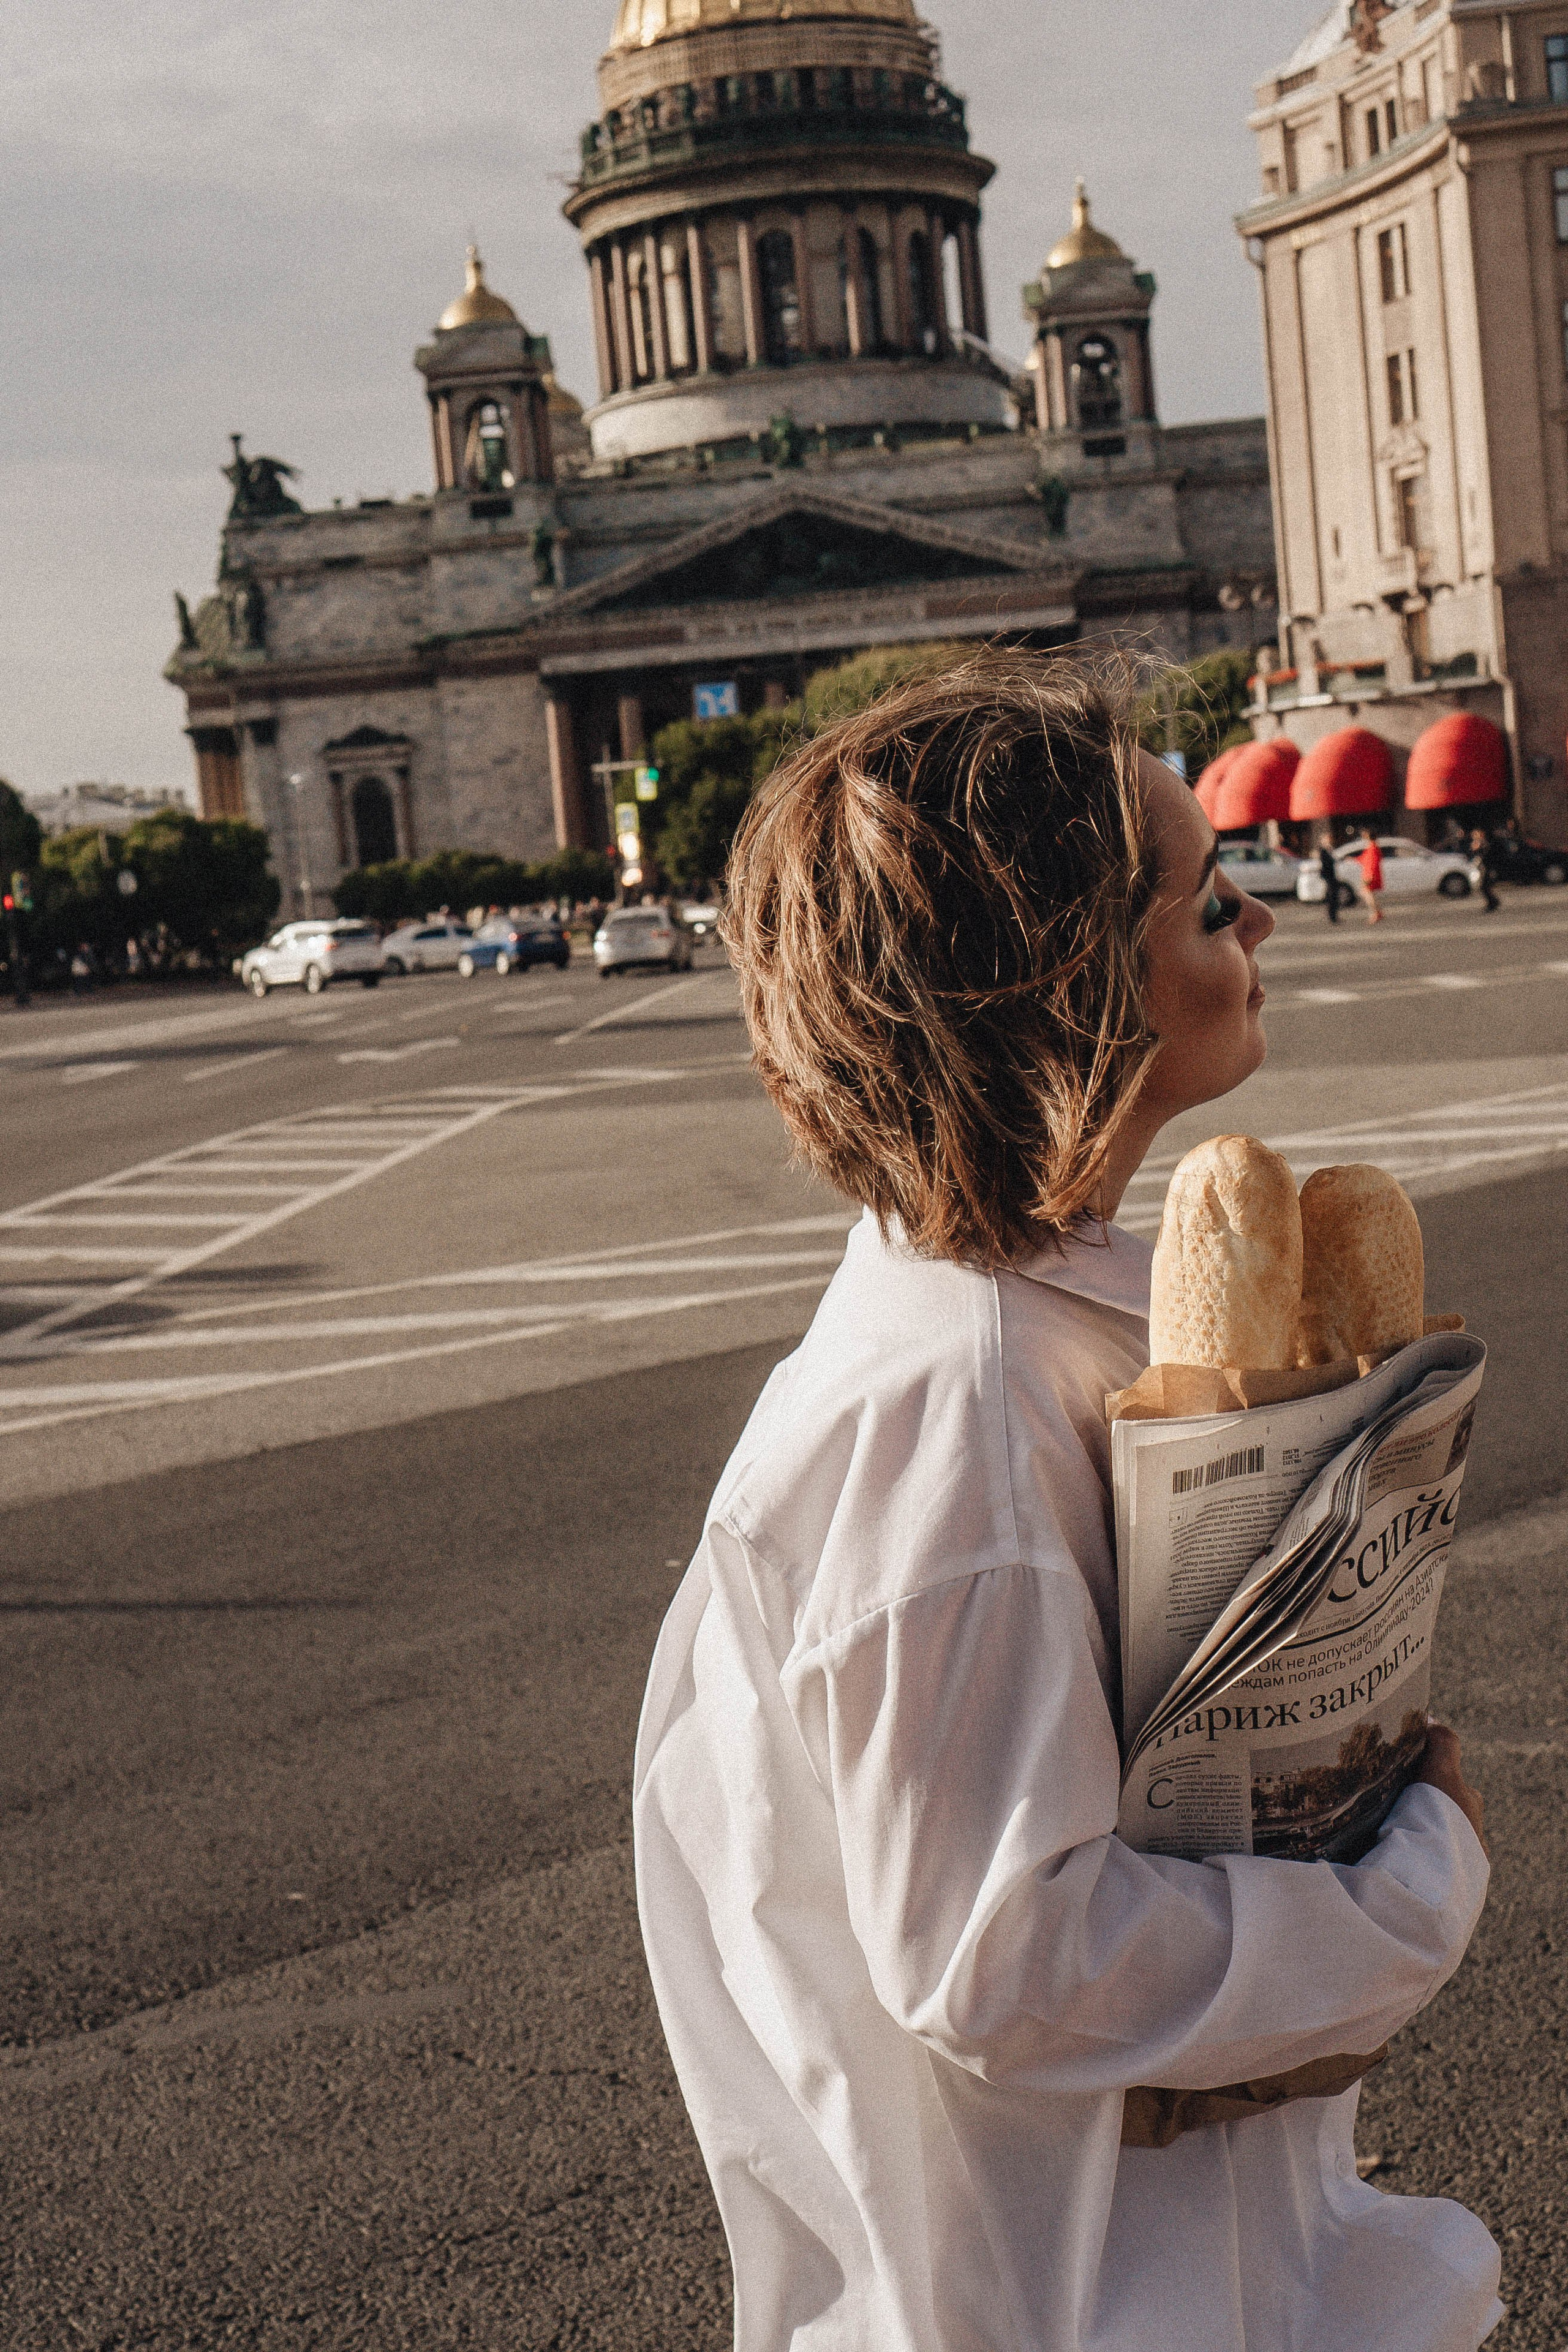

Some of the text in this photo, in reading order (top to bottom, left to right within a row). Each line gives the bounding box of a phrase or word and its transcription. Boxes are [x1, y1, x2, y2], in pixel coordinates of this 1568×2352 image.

[1227, 1577, 1434, 1691] еждам попасть на Олимпиаду-2024?
[1253, 1657, 1283, 1673] ОК
[1287, 1657, 1305, 1670] не
[1308, 1627, 1373, 1667] допускает
[1374, 1594, 1404, 1638] россиян
[1404, 1584, 1415, 1600] на
[1298, 1627, 1321, 1638] ходит
[1325, 1617, 1351, 1630] ноября
